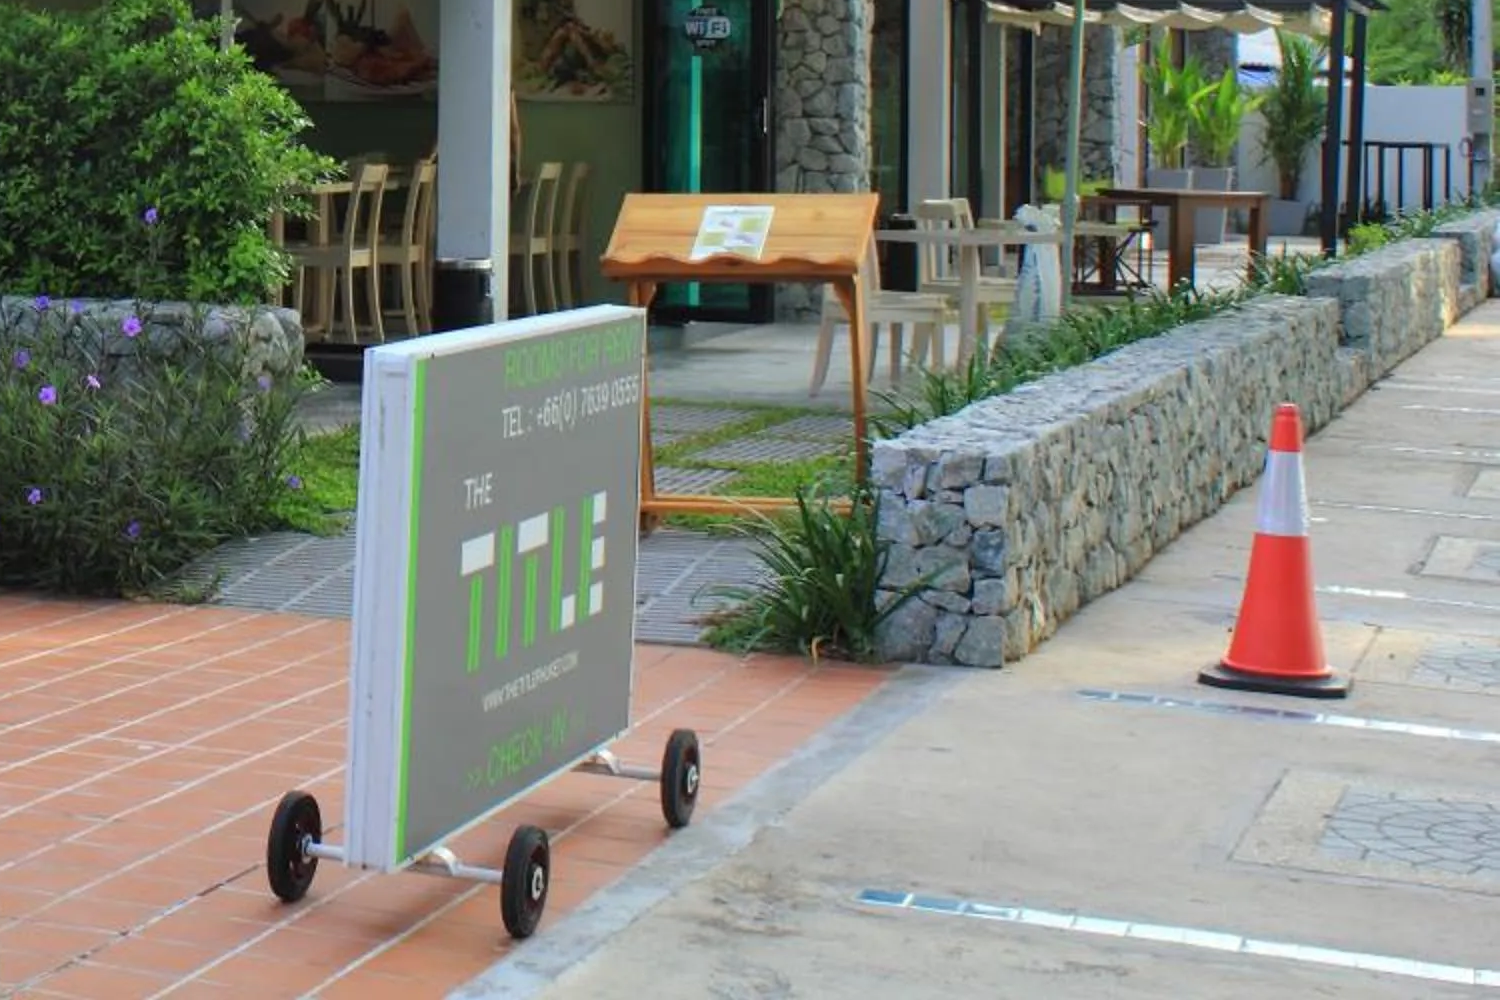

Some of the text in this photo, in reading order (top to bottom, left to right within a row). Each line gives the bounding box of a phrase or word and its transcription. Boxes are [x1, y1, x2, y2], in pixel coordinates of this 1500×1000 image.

[536, 387, 578, 433] +66(0)
[463, 471, 493, 510] THE
[461, 490, 607, 674] TITLE
